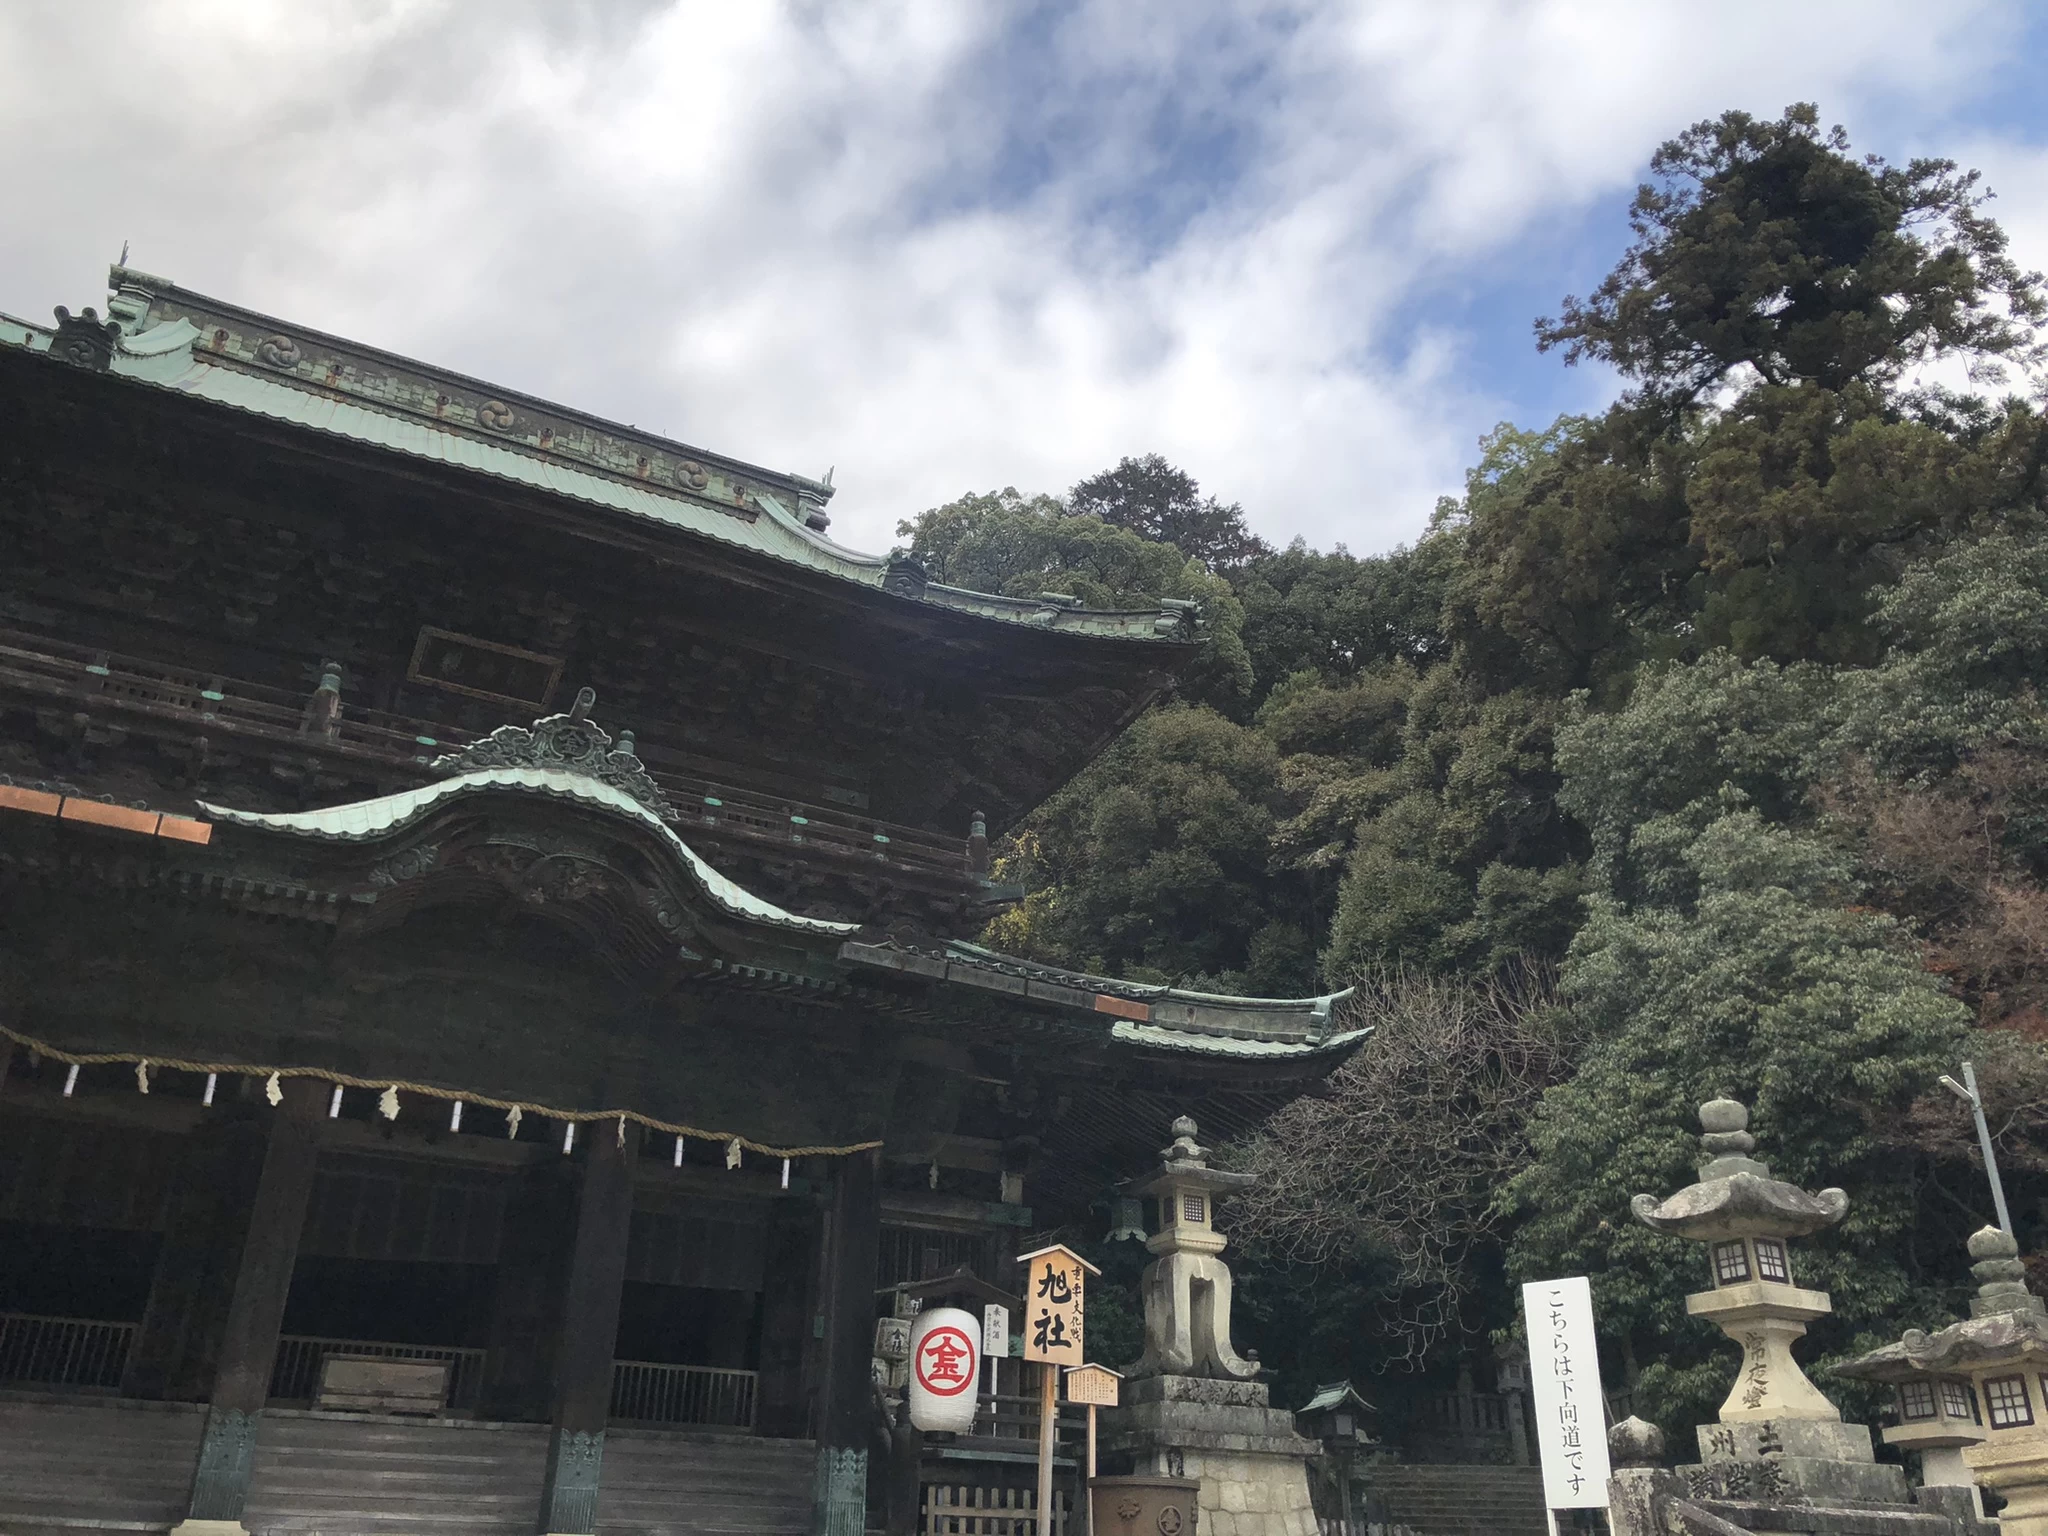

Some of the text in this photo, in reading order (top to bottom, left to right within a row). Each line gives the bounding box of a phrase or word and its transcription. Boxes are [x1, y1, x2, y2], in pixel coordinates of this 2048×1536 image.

[1033, 1262, 1072, 1354] 旭社
[925, 1335, 968, 1384] 金
[1548, 1289, 1586, 1497] こちらは下向道です
